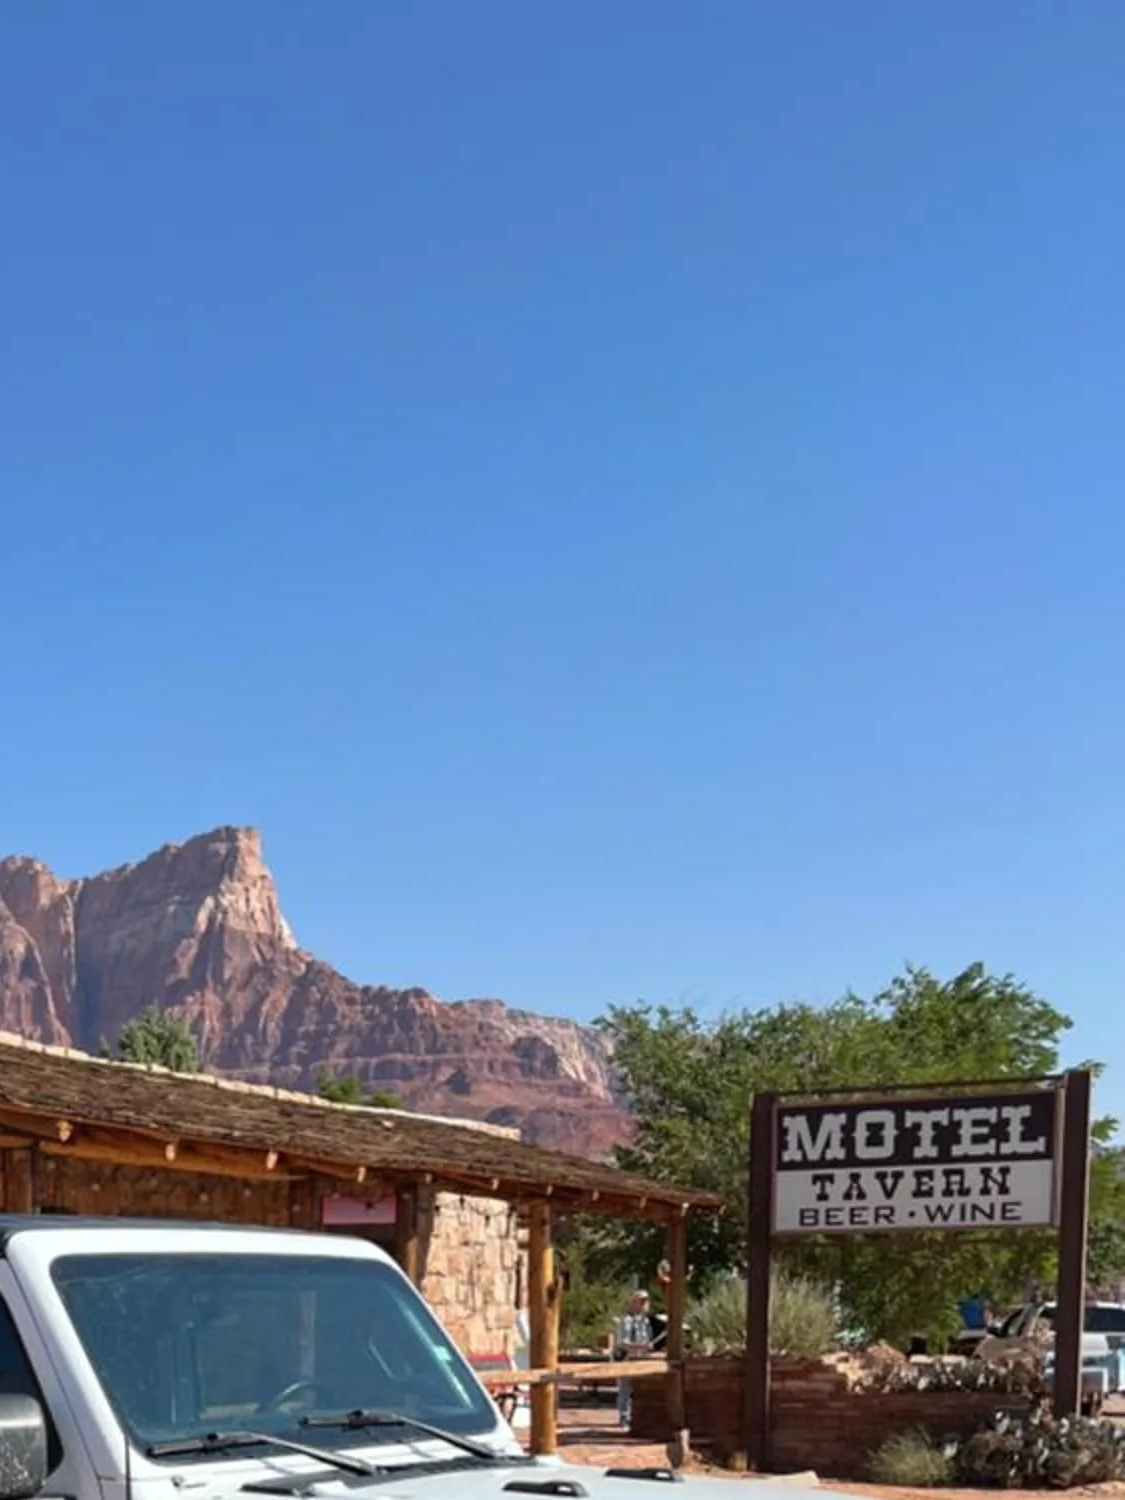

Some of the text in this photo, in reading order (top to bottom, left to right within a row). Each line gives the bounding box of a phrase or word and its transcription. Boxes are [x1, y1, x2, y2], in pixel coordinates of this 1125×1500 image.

[781, 1104, 1046, 1163] MOTEL
[811, 1166, 1012, 1201] TAVERN
[799, 1201, 1023, 1227] BEER WINE
